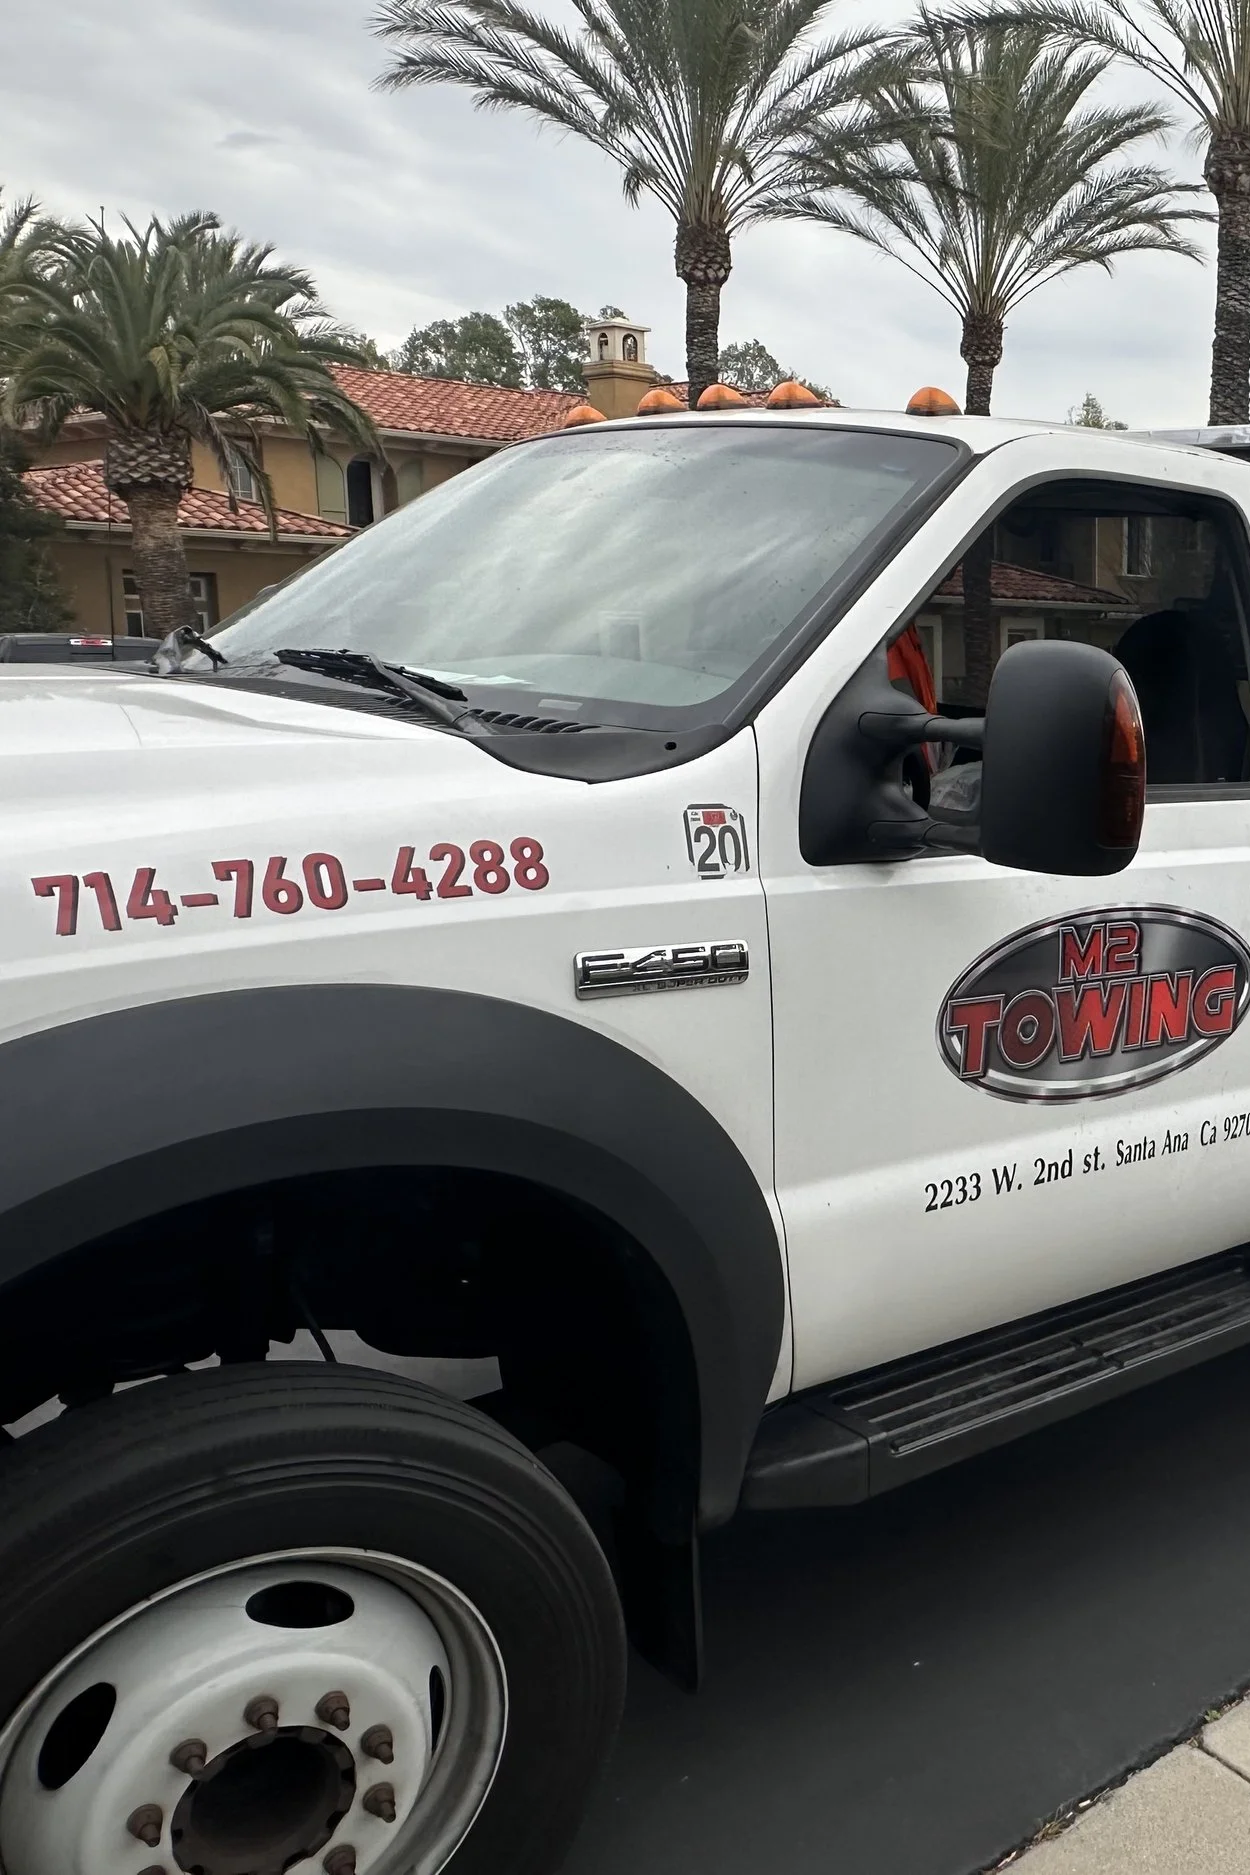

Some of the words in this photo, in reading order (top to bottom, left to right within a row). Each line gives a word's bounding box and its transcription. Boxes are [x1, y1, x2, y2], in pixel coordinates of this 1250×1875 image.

[31, 837, 549, 936] 714-760-4288
[694, 825, 741, 872] 20
[581, 943, 748, 984] F-450
[1057, 921, 1142, 984] M2
[947, 964, 1238, 1078] TOWING
[925, 1172, 982, 1213] 2233
[992, 1163, 1023, 1196] W.
[1033, 1149, 1073, 1186] 2nd
[1082, 1145, 1105, 1174] st.
[1116, 1136, 1156, 1168] Santa
[1162, 1129, 1189, 1154] Ana
[1200, 1121, 1217, 1147] Ca
